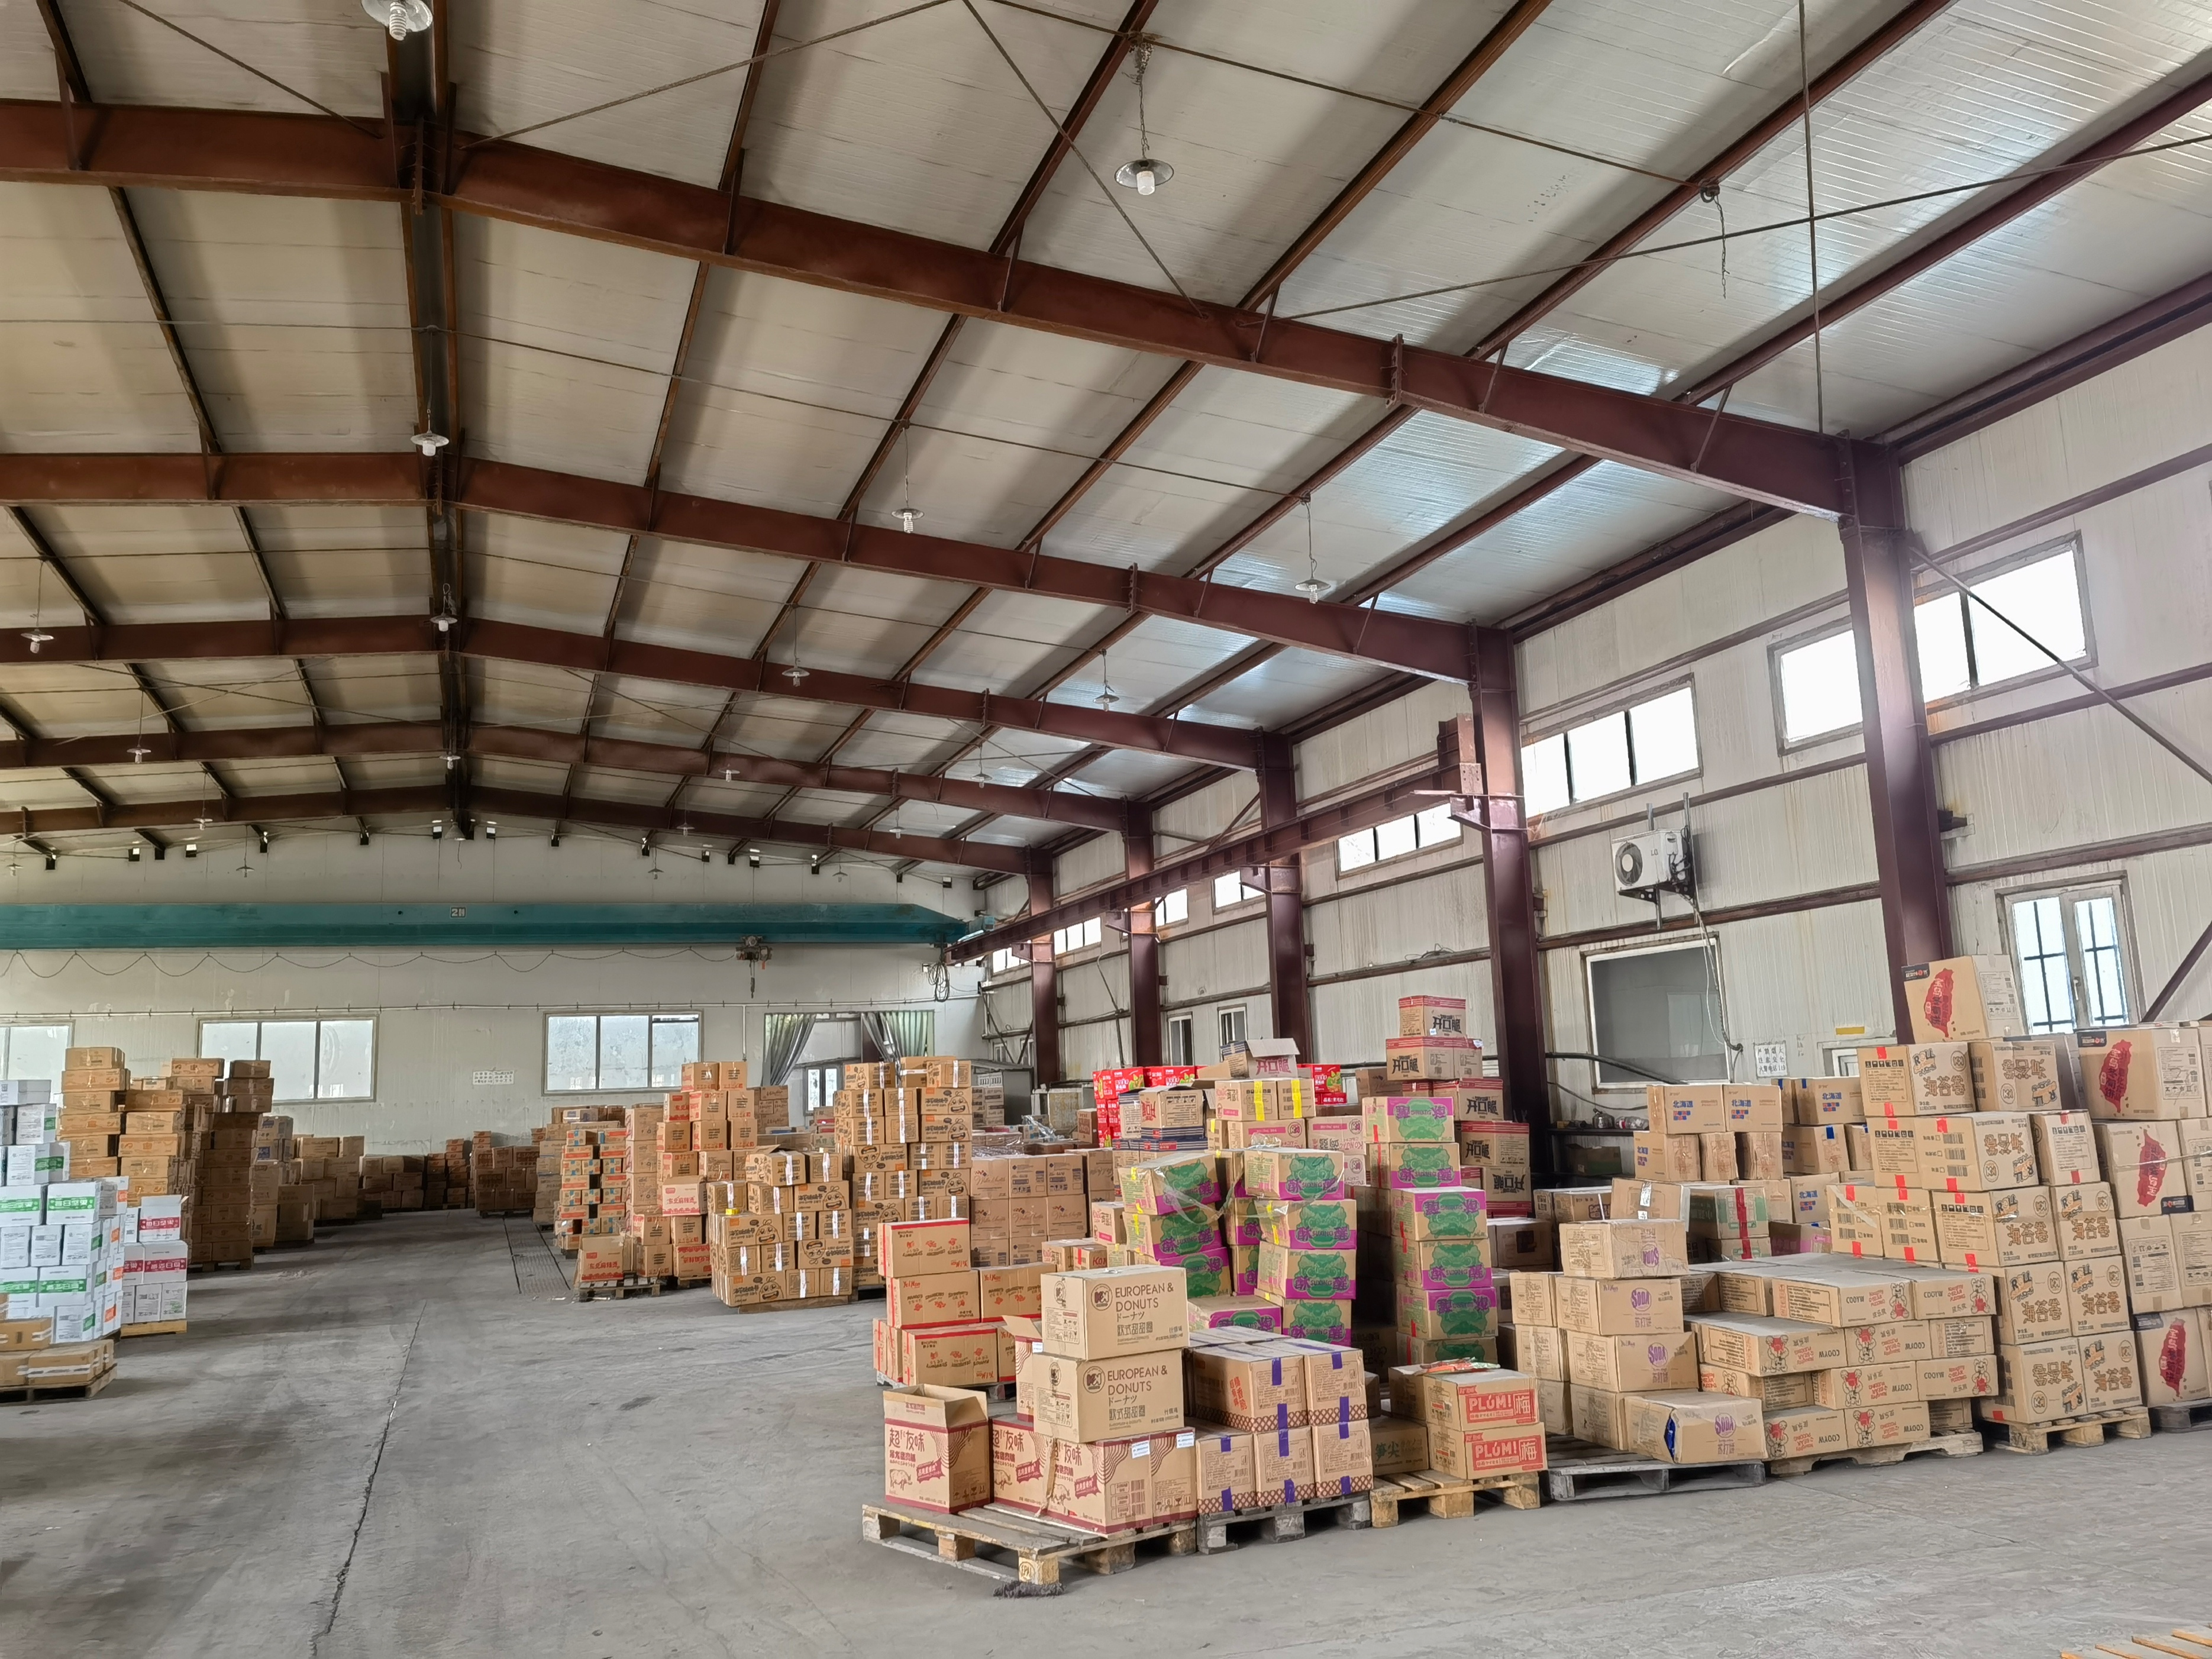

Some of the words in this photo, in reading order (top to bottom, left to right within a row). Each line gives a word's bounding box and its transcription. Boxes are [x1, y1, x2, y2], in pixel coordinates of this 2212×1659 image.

[1256, 1057, 1292, 1076] 开口脆
[1115, 1283, 1165, 1298] EUROPEAN
[1167, 1282, 1174, 1292] &
[1116, 1297, 1158, 1312] DONUTS
[1631, 1289, 1650, 1309] SODA
[1116, 1311, 1145, 1322] ドーナツ
[1648, 1345, 1667, 1364] SODA
[1107, 1366, 1158, 1382] EUROPEAN
[1161, 1365, 1168, 1375] &
[1108, 1380, 1151, 1396] DONUTS
[1109, 1395, 1137, 1407] ドーナツ
[1516, 1396, 1530, 1414] 梅
[1716, 1415, 1734, 1435] SODA
[1521, 1442, 1537, 1460] 梅
